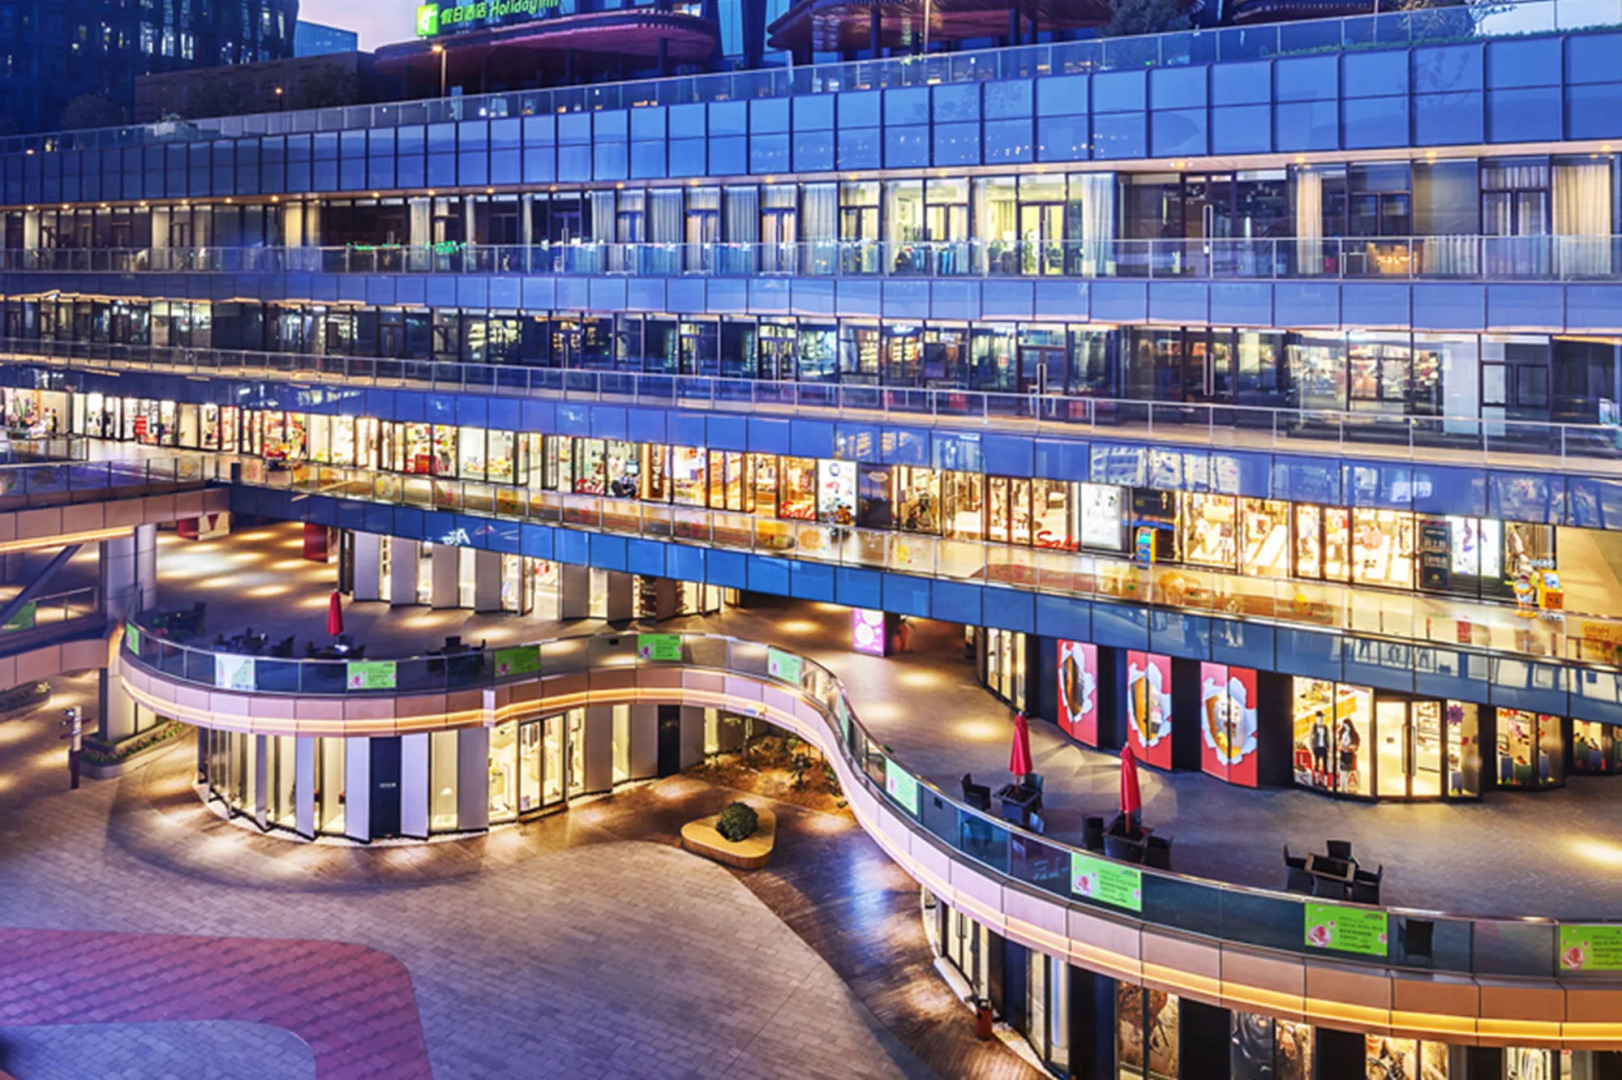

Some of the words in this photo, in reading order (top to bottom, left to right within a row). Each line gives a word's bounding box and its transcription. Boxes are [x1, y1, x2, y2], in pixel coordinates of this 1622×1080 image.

[489, 0, 538, 18] Holiday
[779, 500, 817, 520] Sale
[1033, 530, 1080, 552] Sale
